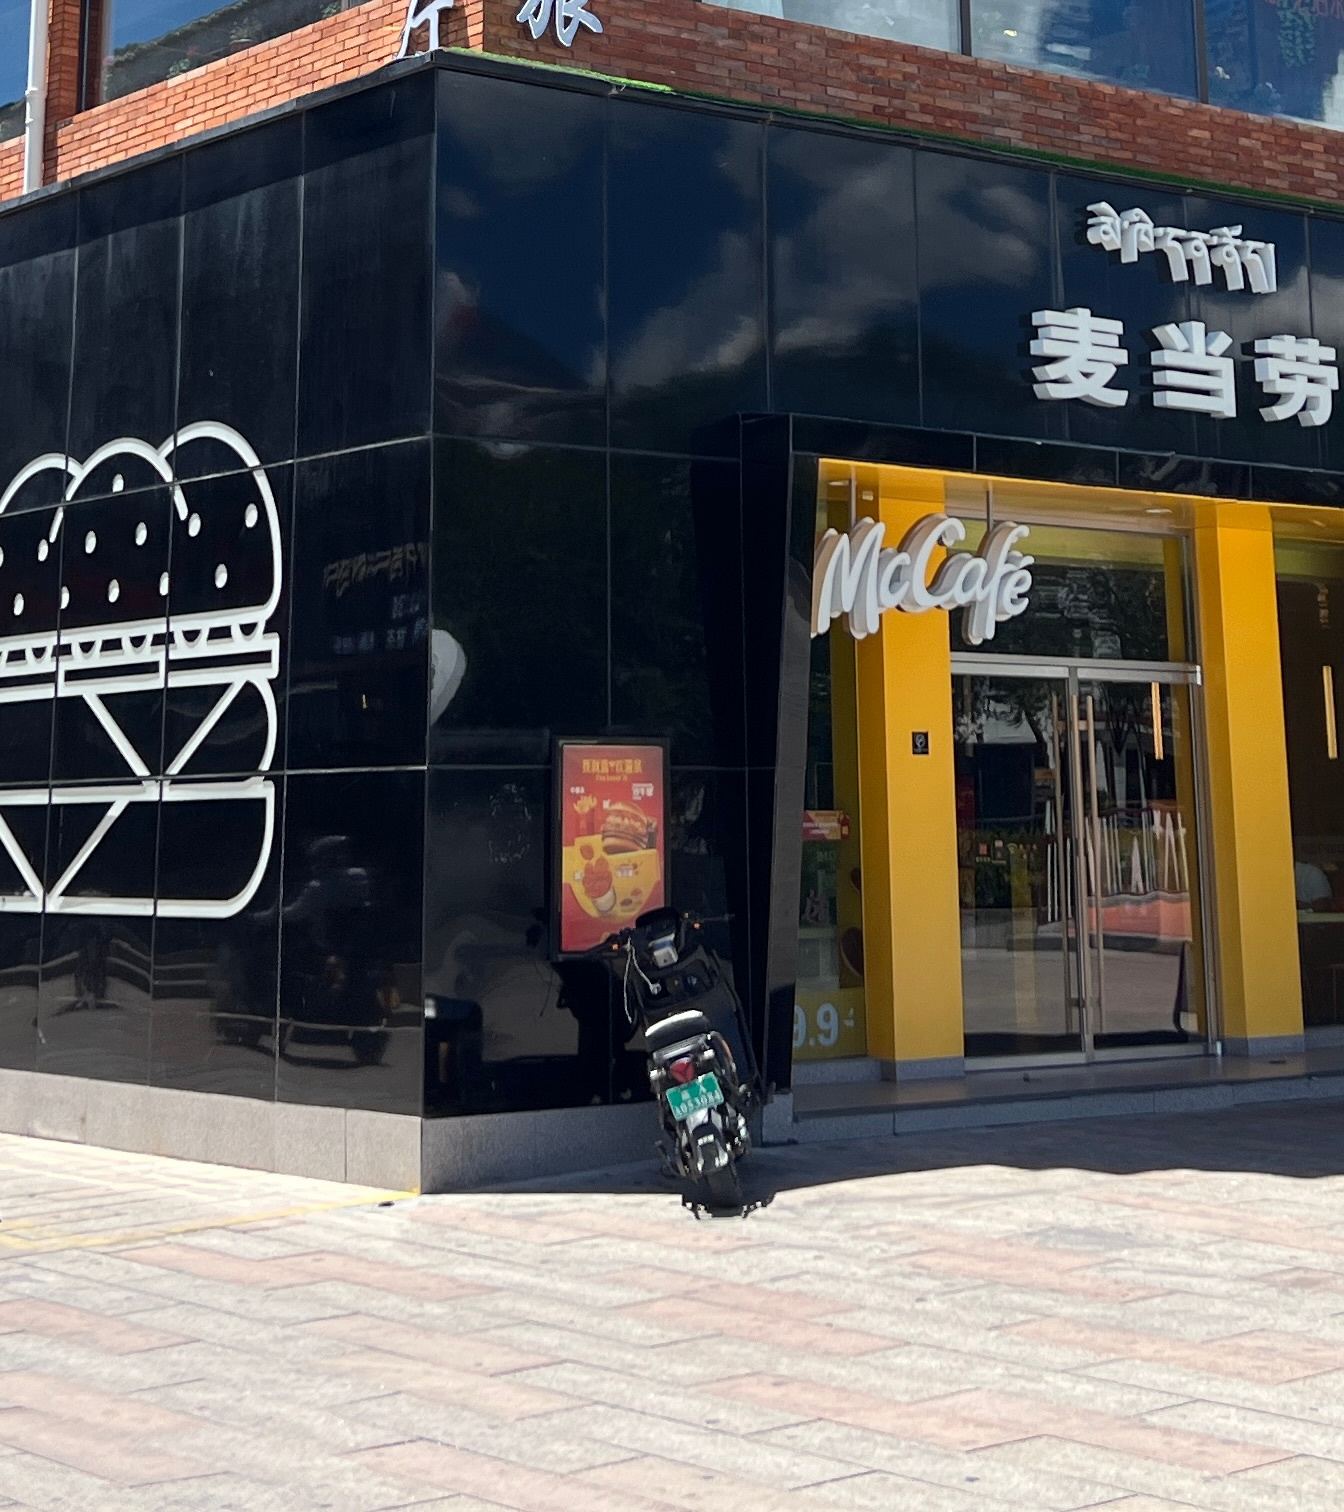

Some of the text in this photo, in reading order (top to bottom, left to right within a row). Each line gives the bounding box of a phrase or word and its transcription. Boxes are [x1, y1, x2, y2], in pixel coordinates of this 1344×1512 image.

[1031, 306, 1340, 427] 麦当劳
[811, 513, 1034, 645] McCafé
